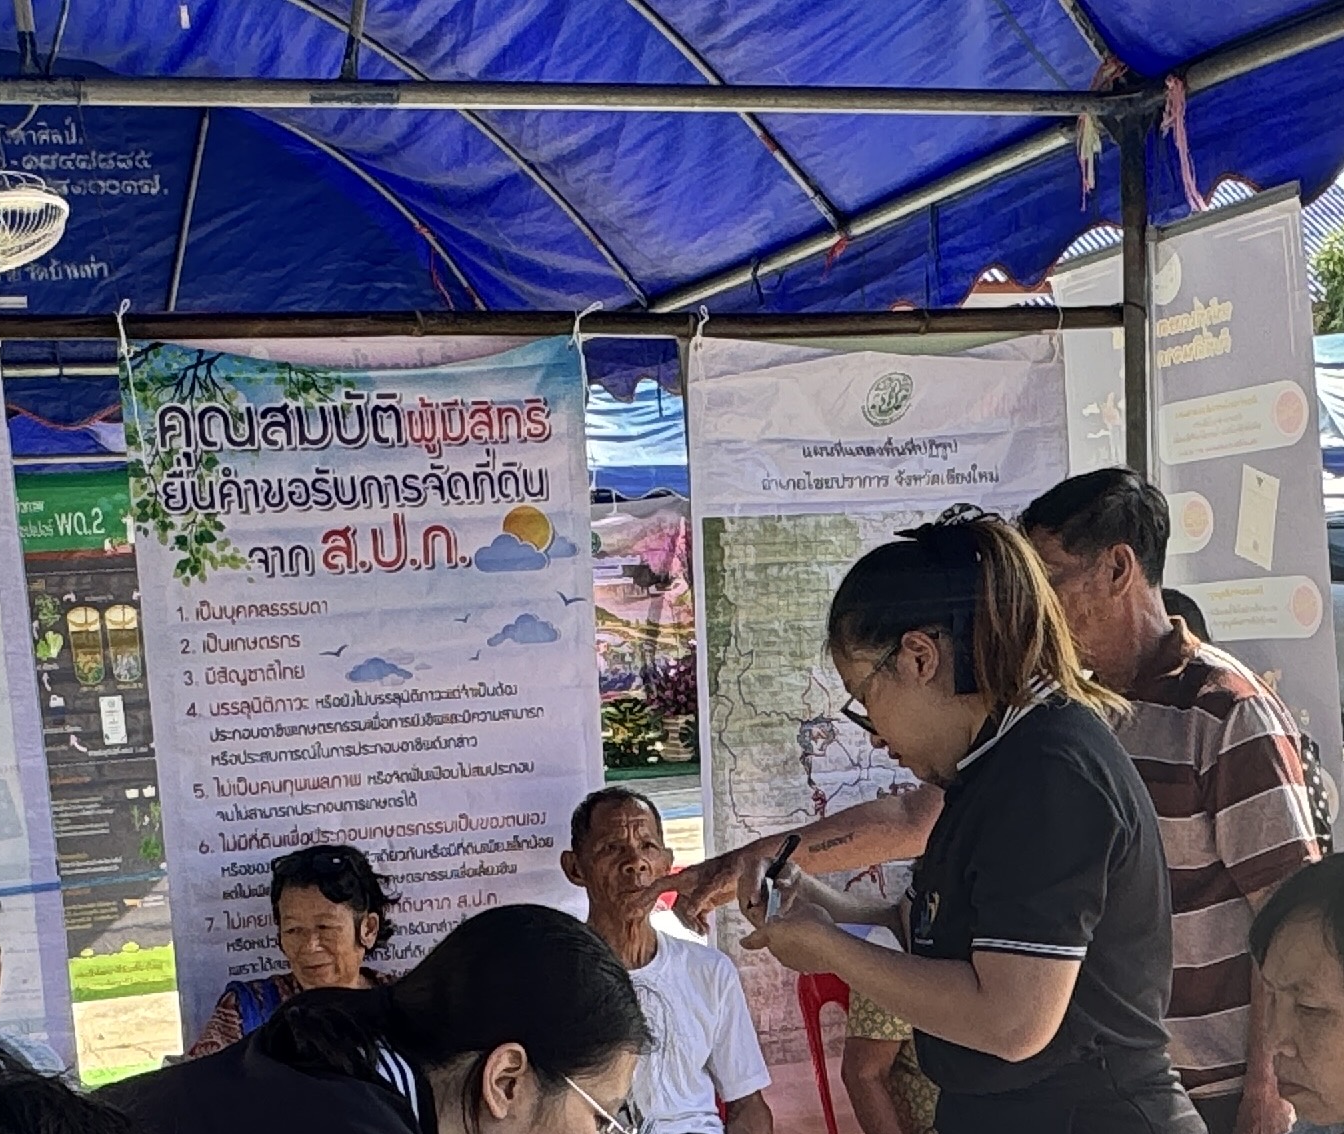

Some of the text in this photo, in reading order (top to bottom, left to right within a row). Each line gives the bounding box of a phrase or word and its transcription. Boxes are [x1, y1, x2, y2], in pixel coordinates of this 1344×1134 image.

[248, 513, 472, 576] จาก ส.ป.ก.
[176, 606, 191, 623] 1.
[181, 638, 197, 655] 2.
[184, 670, 199, 687] 3.
